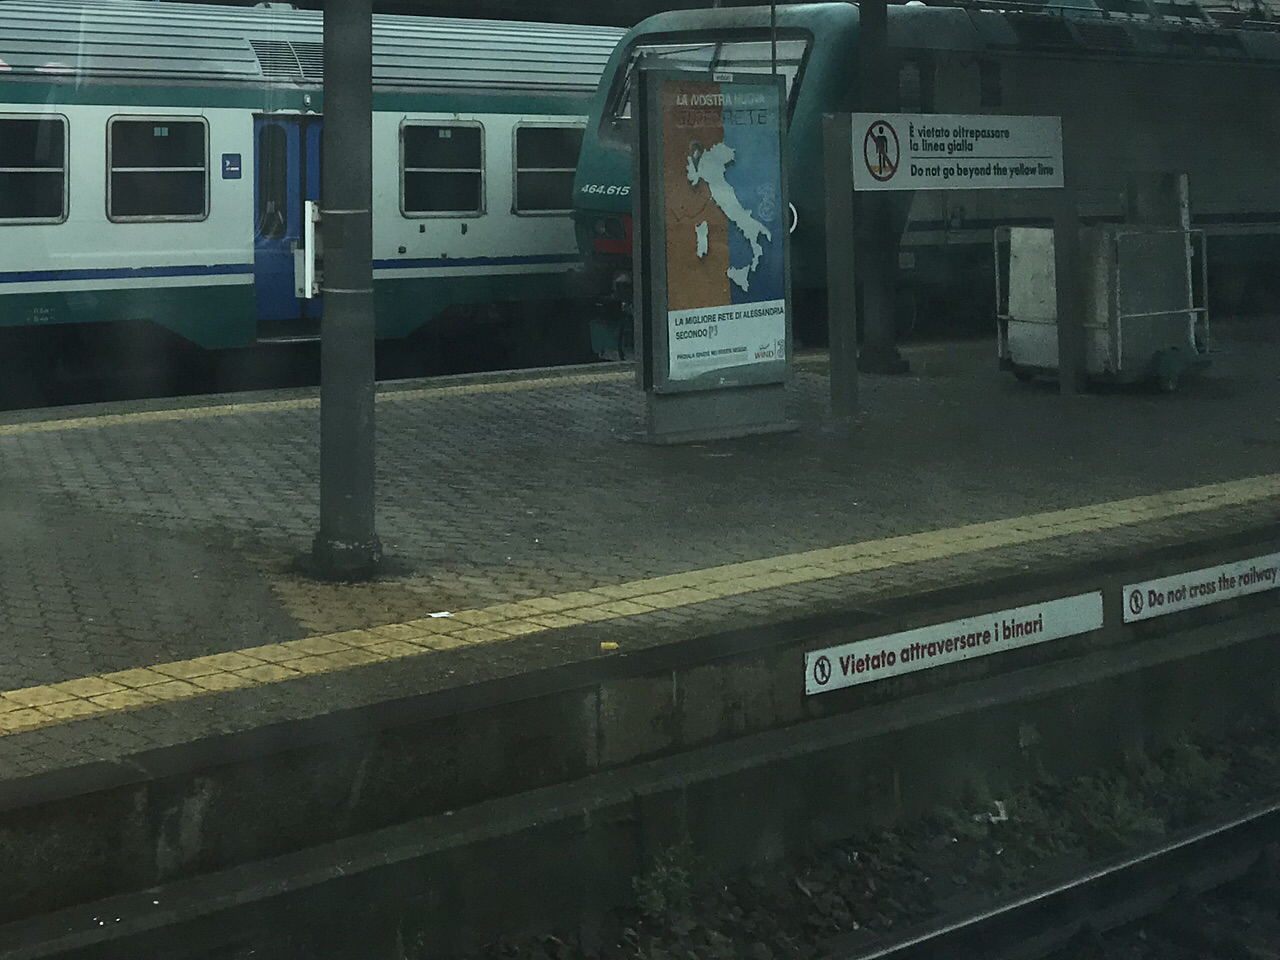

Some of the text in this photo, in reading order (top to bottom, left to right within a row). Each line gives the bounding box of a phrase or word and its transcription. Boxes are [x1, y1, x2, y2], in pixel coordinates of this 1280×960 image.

[690, 93, 732, 106] NOSTRA
[918, 125, 950, 139] vietato
[953, 125, 1010, 141] oltrepassare
[909, 138, 974, 154] la linea gialla
[910, 163, 1054, 179] Do not go beyond the yellow line
[581, 184, 631, 196] 464.615
[675, 306, 784, 326] LA MIGLIORE RETE DI ALESSANDRIA
[675, 328, 707, 340] SECONDO
[1147, 565, 1278, 608] Do not cross the railway
[839, 613, 1044, 677] Vietato attraversare i binari
